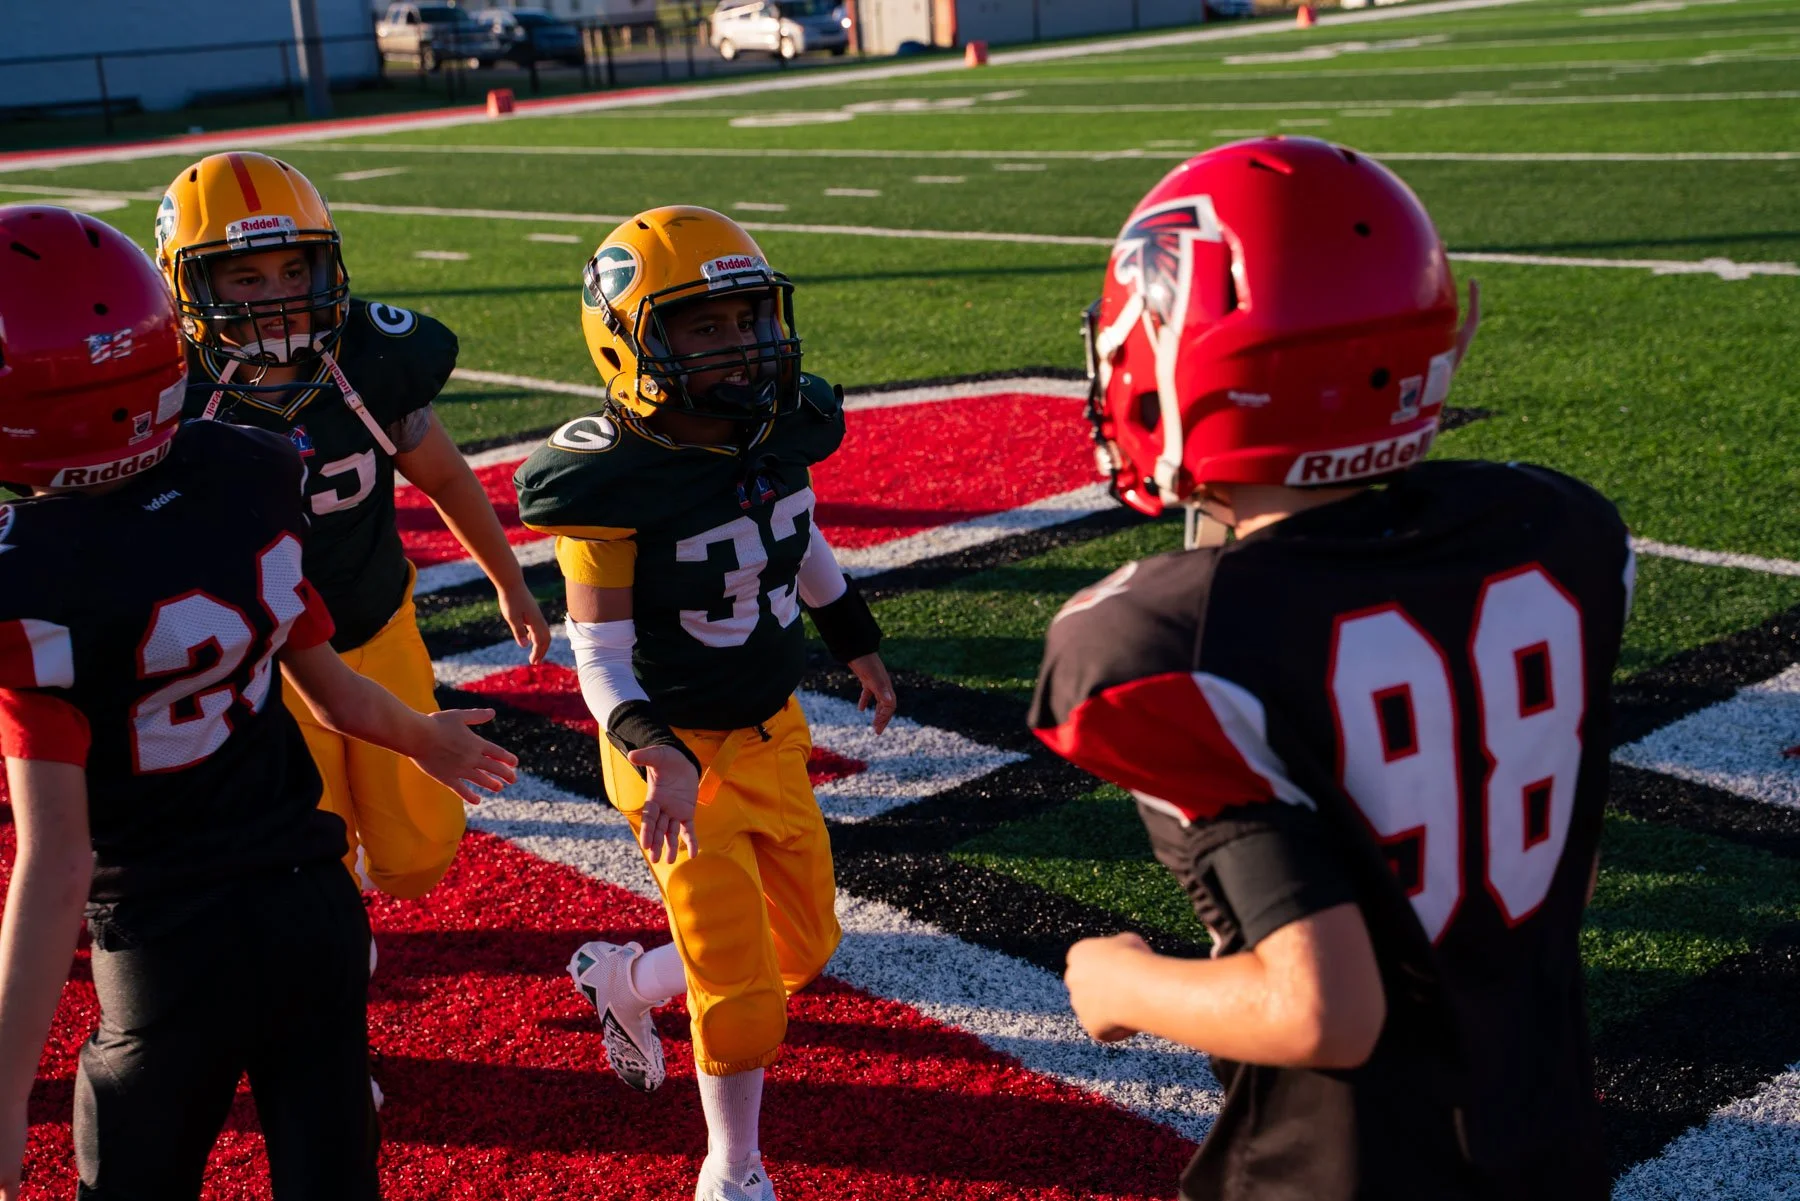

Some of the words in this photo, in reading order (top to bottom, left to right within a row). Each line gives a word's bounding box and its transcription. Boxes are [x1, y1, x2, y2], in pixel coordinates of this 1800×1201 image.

[241, 217, 280, 231] Riddell
[715, 257, 752, 271] Riddell
[553, 416, 615, 450] G
[62, 440, 169, 486] Riddell
[1301, 428, 1435, 482] Riddell
[1325, 561, 1588, 946] 98
